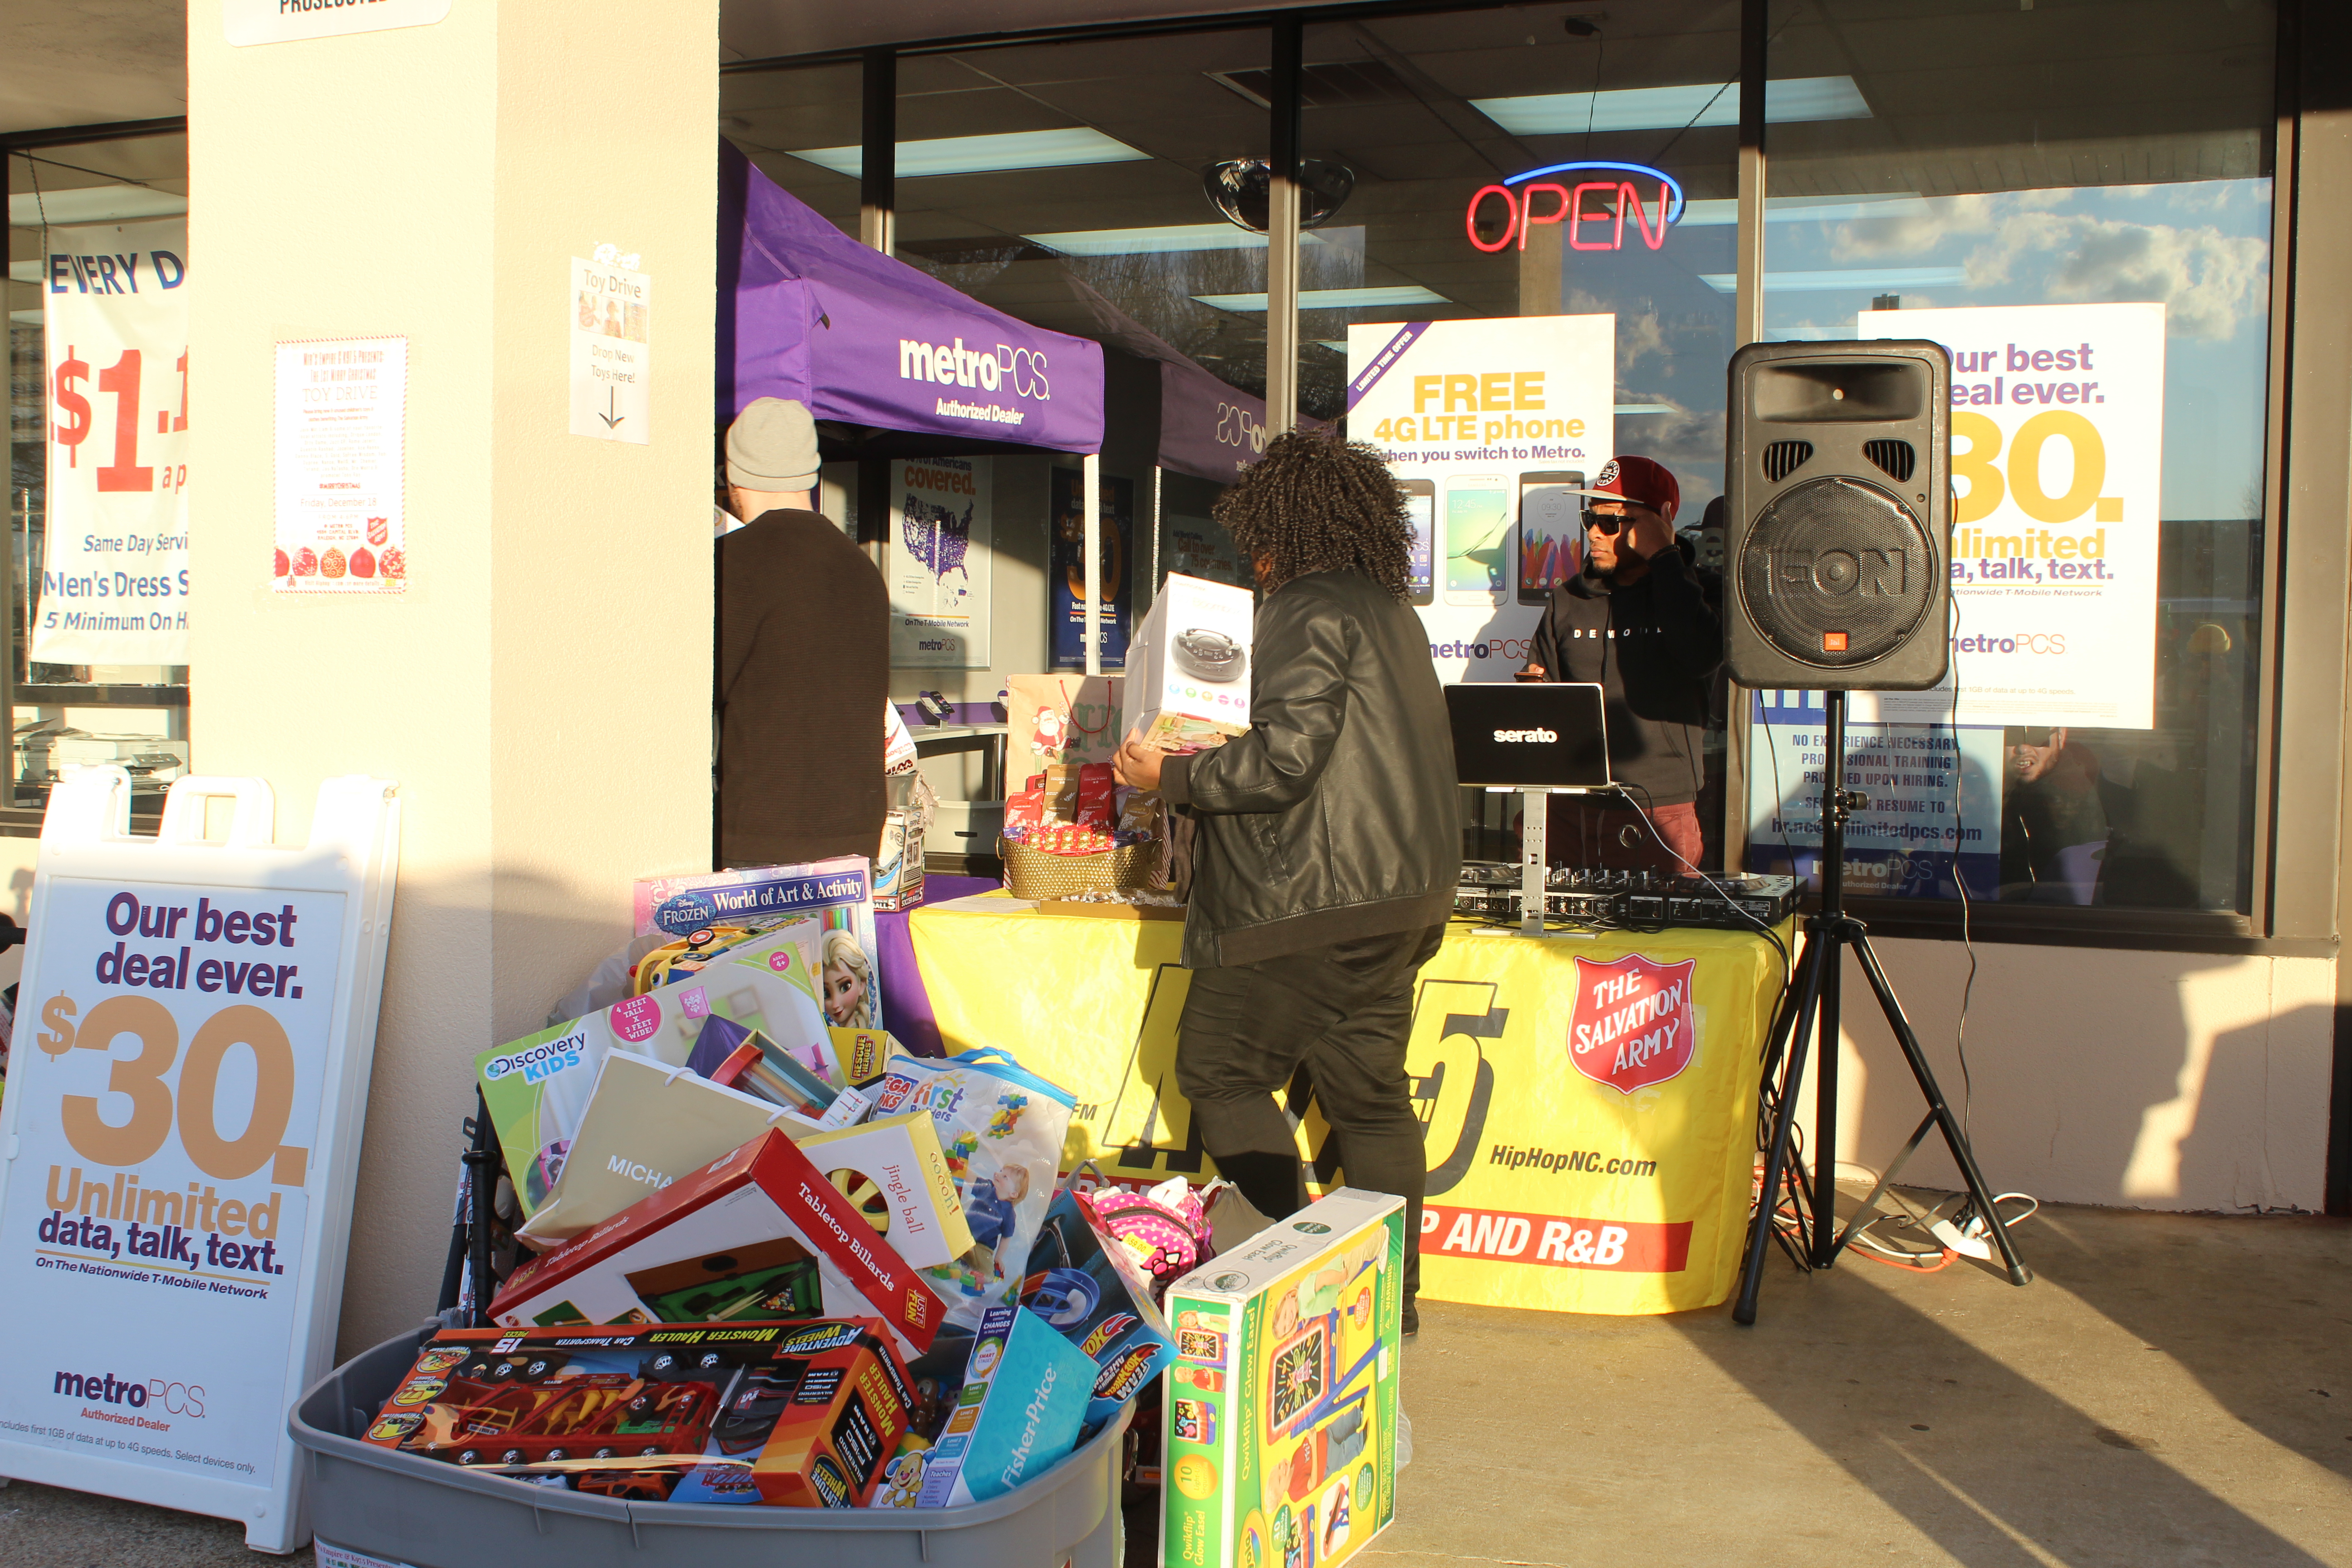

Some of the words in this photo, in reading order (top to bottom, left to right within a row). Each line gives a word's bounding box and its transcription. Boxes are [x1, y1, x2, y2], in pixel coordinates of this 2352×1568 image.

[1467, 182, 1669, 252] OPEN
[50, 253, 139, 294] EVERY
[584, 269, 605, 294] Toy
[609, 275, 641, 298] Drive
[592, 345, 613, 362] Drop
[615, 349, 634, 363] New
[1355, 365, 1381, 392] LIMITED
[1377, 349, 1395, 368] TIME
[1392, 330, 1413, 353] OFFER
[2007, 343, 2093, 372] best
[591, 364, 610, 381] Toys
[612, 369, 635, 383] Here!
[900, 338, 1050, 400] metroPCS
[302, 387, 331, 402] TOY
[336, 386, 377, 400] DRIVE
[1414, 371, 1546, 413] FREE
[2011, 382, 2105, 404] ever.
[936, 397, 991, 421] Authorized
[992, 406, 1024, 425] Dealer
[1374, 417, 1416, 442] 4G
[1422, 415, 1477, 441] LTE
[1485, 414, 1585, 445] phone
[1422, 450, 1450, 464] you
[1454, 447, 1509, 461] switch
[1511, 447, 1528, 459] to
[1532, 445, 1585, 459] Metro.
[905, 466, 976, 495] covered.
[301, 498, 326, 509] Friday,
[328, 498, 365, 507] December
[368, 498, 377, 506] 18
[1452, 500, 1476, 509] 12:45
[84, 535, 122, 552] Same
[126, 534, 153, 556] Day
[44, 571, 109, 598] Men's
[115, 571, 172, 598] Dress
[1979, 558, 2042, 584] talk,
[2048, 559, 2114, 580] text.
[1071, 602, 1081, 610] Fast
[44, 612, 58, 628] 5
[64, 612, 145, 631] Minimum
[149, 613, 172, 630] On
[919, 639, 955, 651] metroPCS
[1494, 727, 1558, 743] serato
[1793, 735, 1808, 746] NO
[1894, 756, 1951, 769] TRAINING
[1866, 774, 1899, 786] UPON
[1902, 774, 1948, 787] HIRING.
[1877, 800, 1926, 813] RESUME
[1930, 801, 1945, 813] TO
[910, 818, 921, 827] BRINE
[713, 889, 758, 911] World
[760, 888, 774, 906] of
[776, 885, 799, 904] Art
[802, 882, 814, 900] &
[816, 877, 863, 899] Activity
[1882, 882, 1907, 890] Dealer
[106, 892, 188, 939] Our
[195, 897, 297, 947] best
[663, 906, 710, 926] FROZEN
[97, 942, 191, 990] deal
[196, 959, 303, 1000] ever.
[1593, 968, 1643, 1009] THE
[623, 1007, 644, 1018] TALL
[627, 997, 647, 1009] FEET
[1575, 979, 1683, 1054] SALVATION
[628, 1027, 653, 1039] WIDE!
[632, 1019, 652, 1031] FEET
[852, 1035, 869, 1079] RESCUE
[862, 1043, 872, 1073] HEROES
[1611, 1018, 1680, 1076] ARMY
[524, 1050, 580, 1082] KIDS
[36, 990, 309, 1187] $30.
[1490, 1145, 1657, 1176] HipHopNC.com
[46, 1165, 281, 1241] Unlimited
[882, 1165, 912, 1203] jingle
[902, 1205, 925, 1234] ball
[39, 1210, 121, 1259] data,
[127, 1222, 200, 1271] talk,
[206, 1233, 284, 1275] text.
[798, 1182, 849, 1243] Tabletop
[848, 1238, 894, 1292] Billards
[1126, 1236, 1147, 1252] $59.00
[1442, 1214, 1532, 1256] AND
[1536, 1221, 1628, 1265] R&B
[36, 1257, 54, 1269] On
[55, 1260, 78, 1272] The
[79, 1263, 150, 1282] Nationwide
[152, 1273, 207, 1290] T-Mobile
[209, 1282, 268, 1299] Network
[1385, 1261, 1393, 1311] WARNING:
[907, 1290, 918, 1321] FUN
[990, 1308, 1011, 1317] Learning
[649, 1331, 706, 1343] HAULER
[706, 1328, 779, 1341] MONSTER
[786, 1325, 842, 1345] WHEELS
[983, 1321, 1010, 1329] CHANGES
[1245, 1306, 1256, 1350] Easel
[491, 1338, 524, 1354] 15
[555, 1337, 610, 1346] TRANSPORTER
[613, 1337, 635, 1346] CAR
[781, 1327, 864, 1354] ADVENTURE
[869, 1362, 899, 1408] HAULER
[1244, 1353, 1254, 1398] Glow
[53, 1371, 206, 1419] metroPCS
[859, 1374, 896, 1437] MONSTER
[81, 1407, 136, 1426] Authorized
[137, 1416, 171, 1432] Dealer
[1001, 1362, 1057, 1490] Fisher-Price
[31, 1423, 47, 1436] first
[48, 1427, 65, 1439] 1GB
[67, 1431, 75, 1440] of
[76, 1433, 94, 1444] data
[96, 1436, 104, 1446] at
[105, 1439, 116, 1449] up
[118, 1441, 126, 1450] to
[128, 1442, 139, 1452] 4G
[141, 1445, 172, 1459] speeds.
[175, 1450, 201, 1464] Select
[203, 1455, 235, 1469] devices
[237, 1462, 256, 1474] only.
[1180, 1466, 1193, 1483] 10
[1182, 1515, 1194, 1560] Qwikflip
[1194, 1510, 1205, 1538] Easel
[1194, 1539, 1205, 1567] Glow
